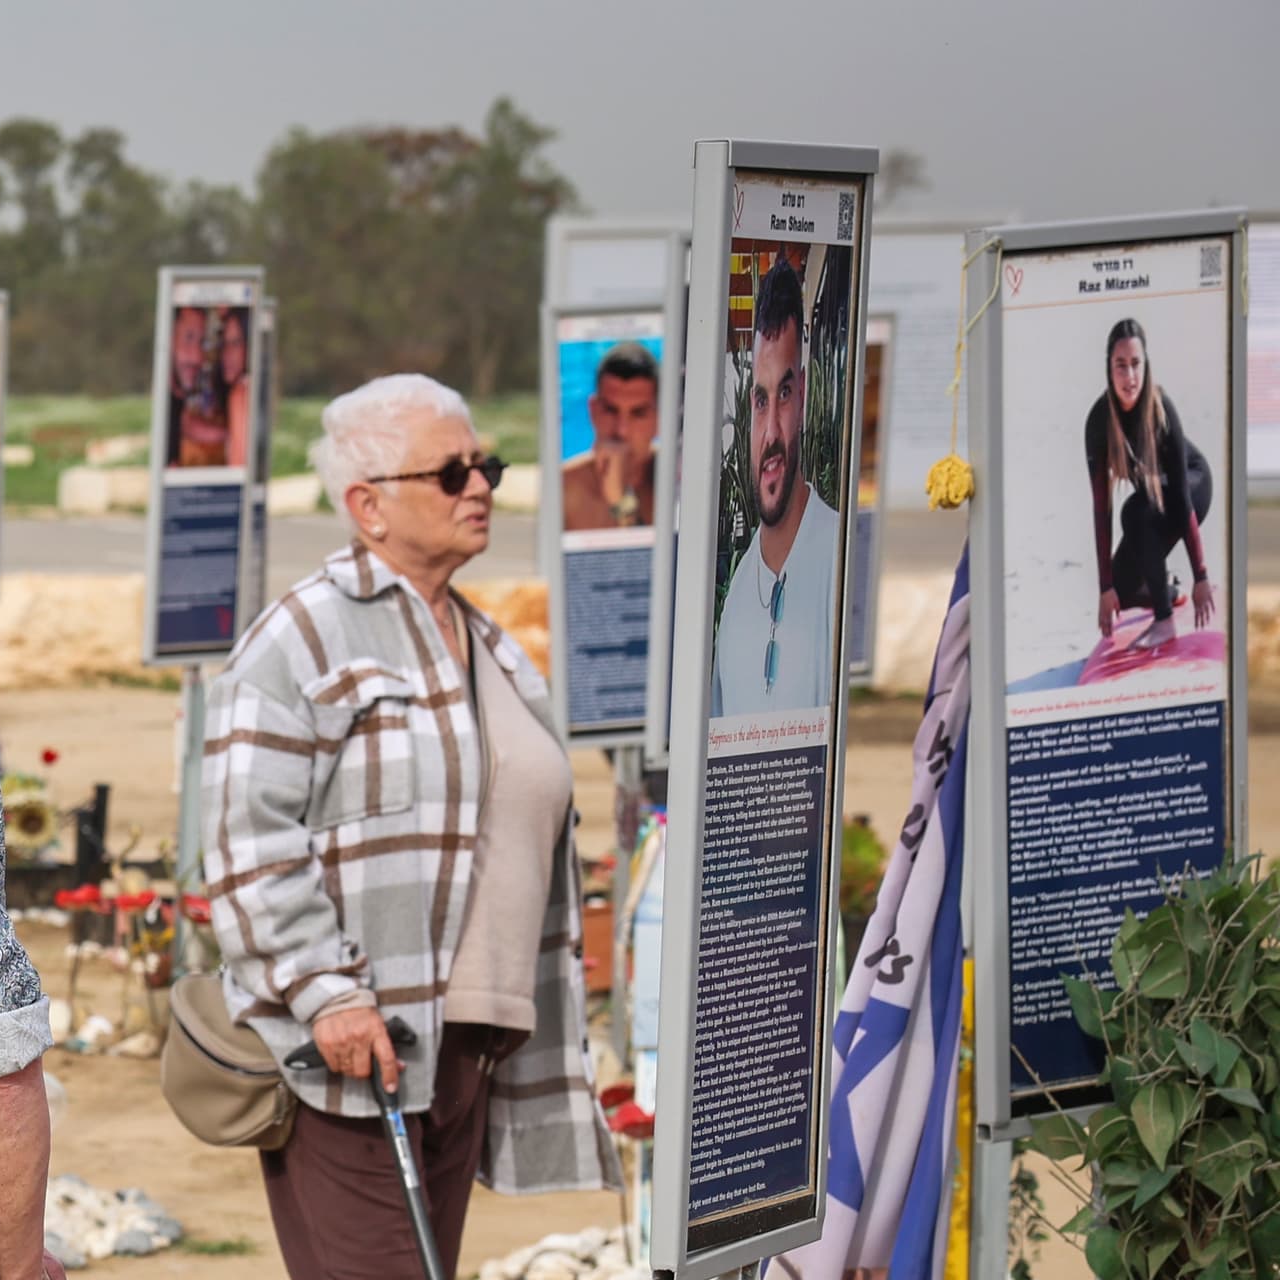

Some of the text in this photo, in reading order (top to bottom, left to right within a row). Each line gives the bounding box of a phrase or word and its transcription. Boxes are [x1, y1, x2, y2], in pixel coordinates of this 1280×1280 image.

[770, 214, 814, 234] Ram Shalom
[1078, 275, 1150, 293] Raz Mizrahi
